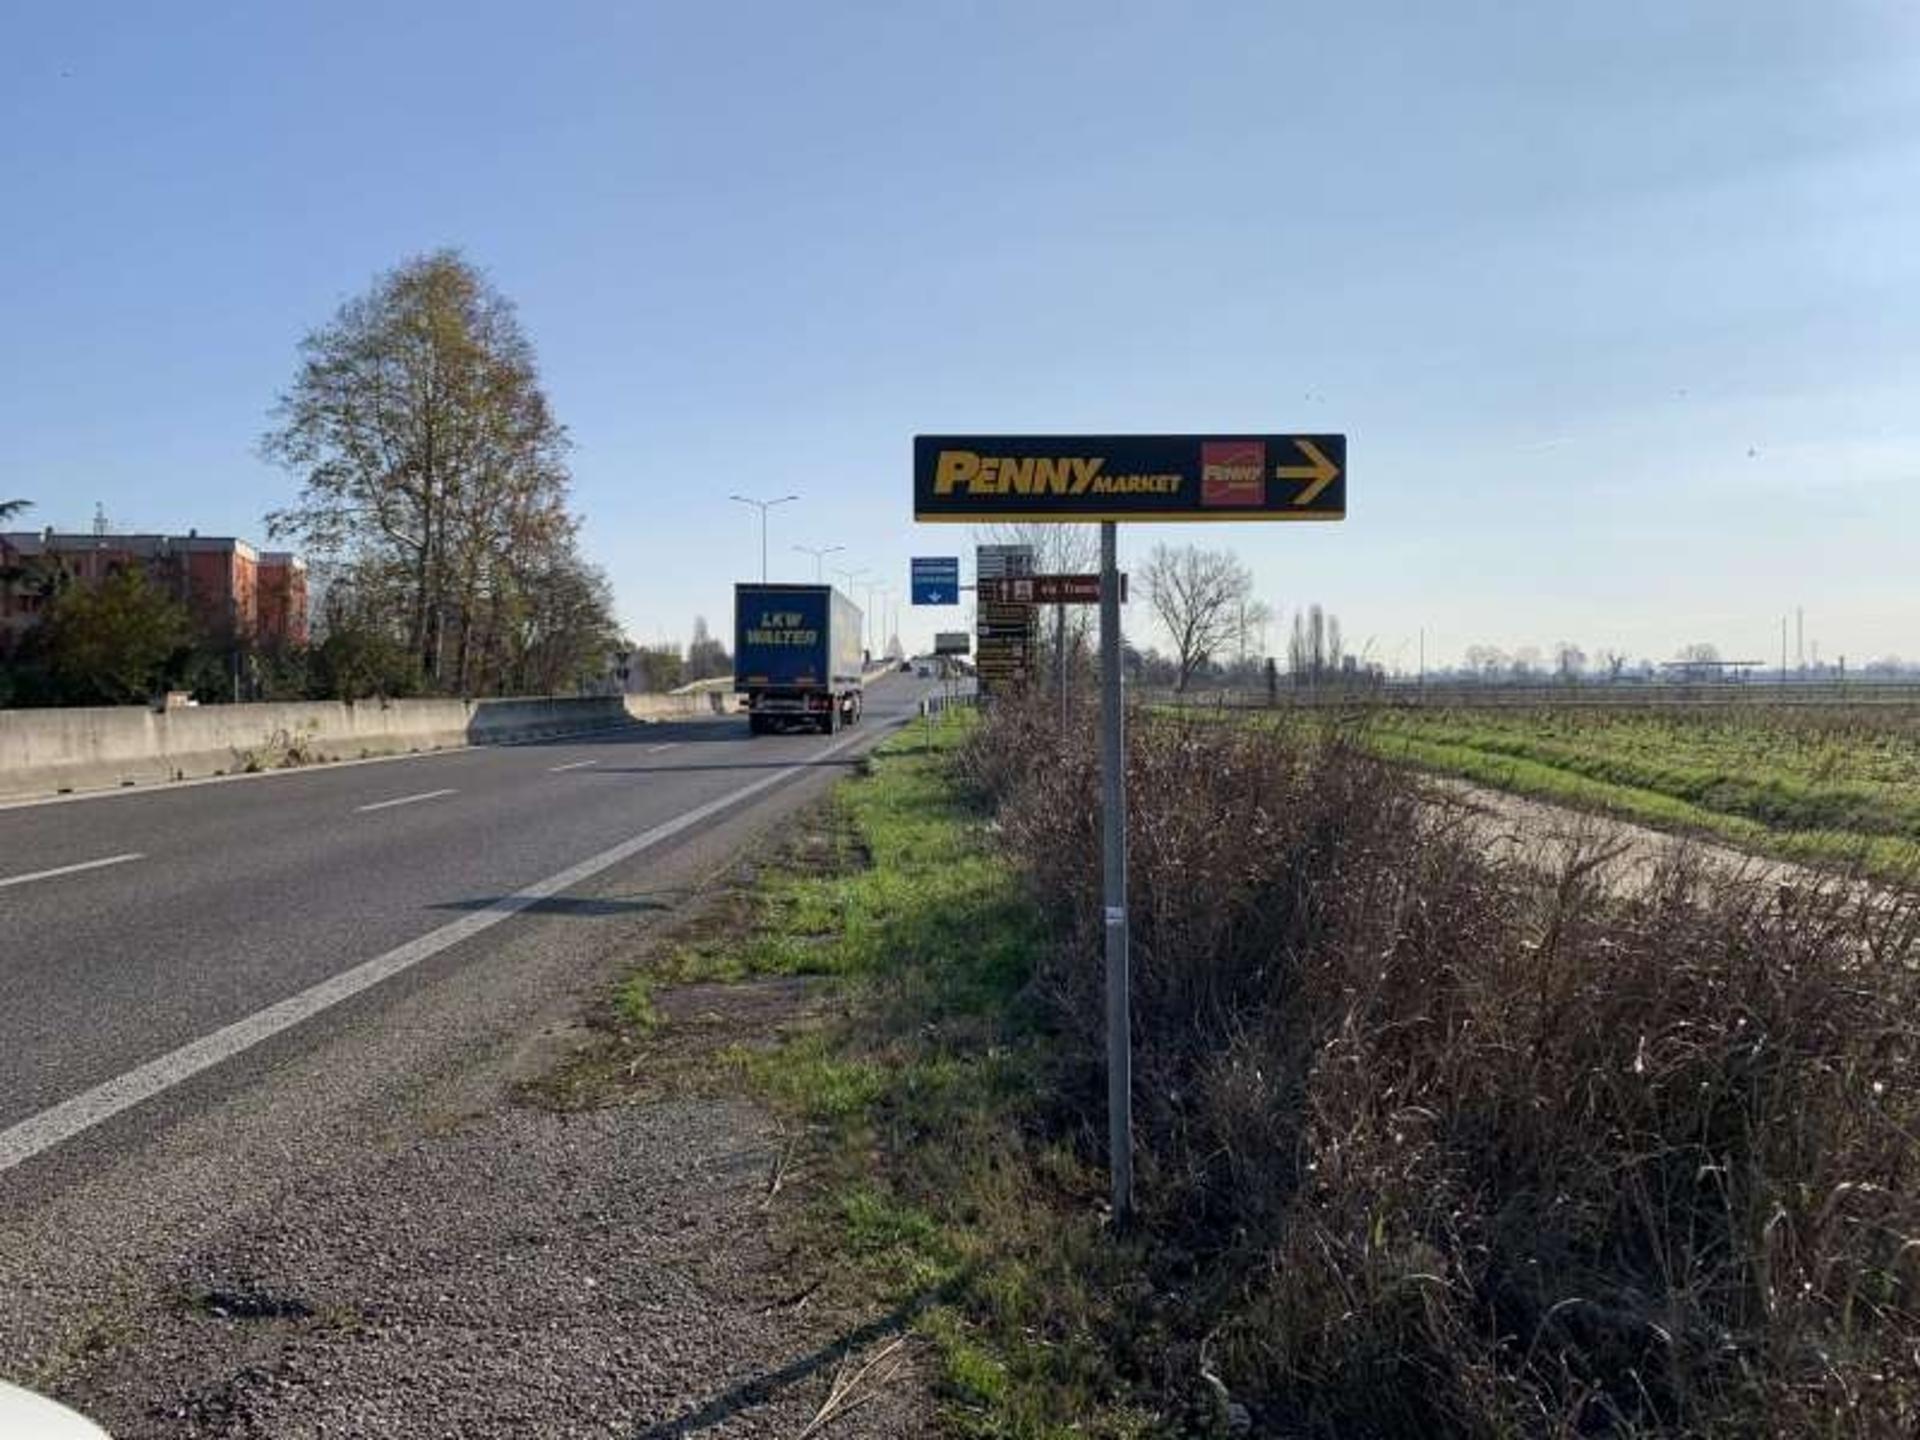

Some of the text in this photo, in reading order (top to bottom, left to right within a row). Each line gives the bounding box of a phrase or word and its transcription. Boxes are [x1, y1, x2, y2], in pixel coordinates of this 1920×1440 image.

[934, 451, 1182, 494] PENNY MARKET
[761, 612, 803, 627] LKW
